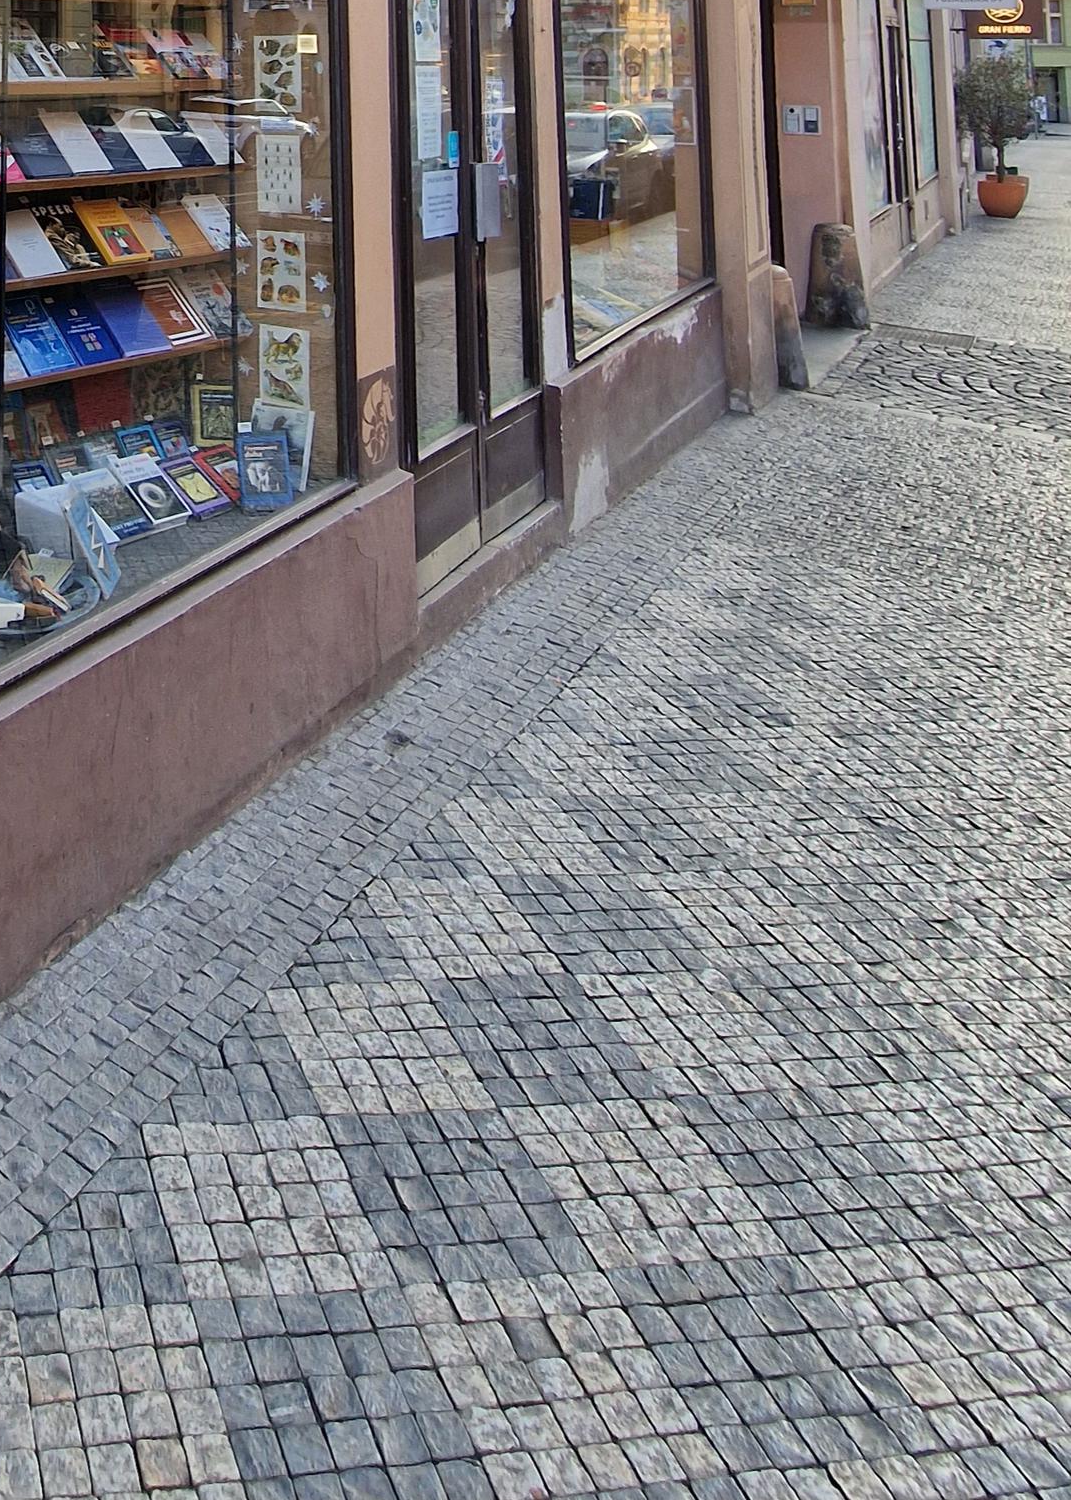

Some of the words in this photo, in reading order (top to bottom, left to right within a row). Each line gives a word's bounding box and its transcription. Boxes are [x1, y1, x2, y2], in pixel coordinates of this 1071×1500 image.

[978, 25, 1001, 34] GRAN
[1002, 25, 1032, 34] FIERRO
[31, 204, 73, 217] SPEER
